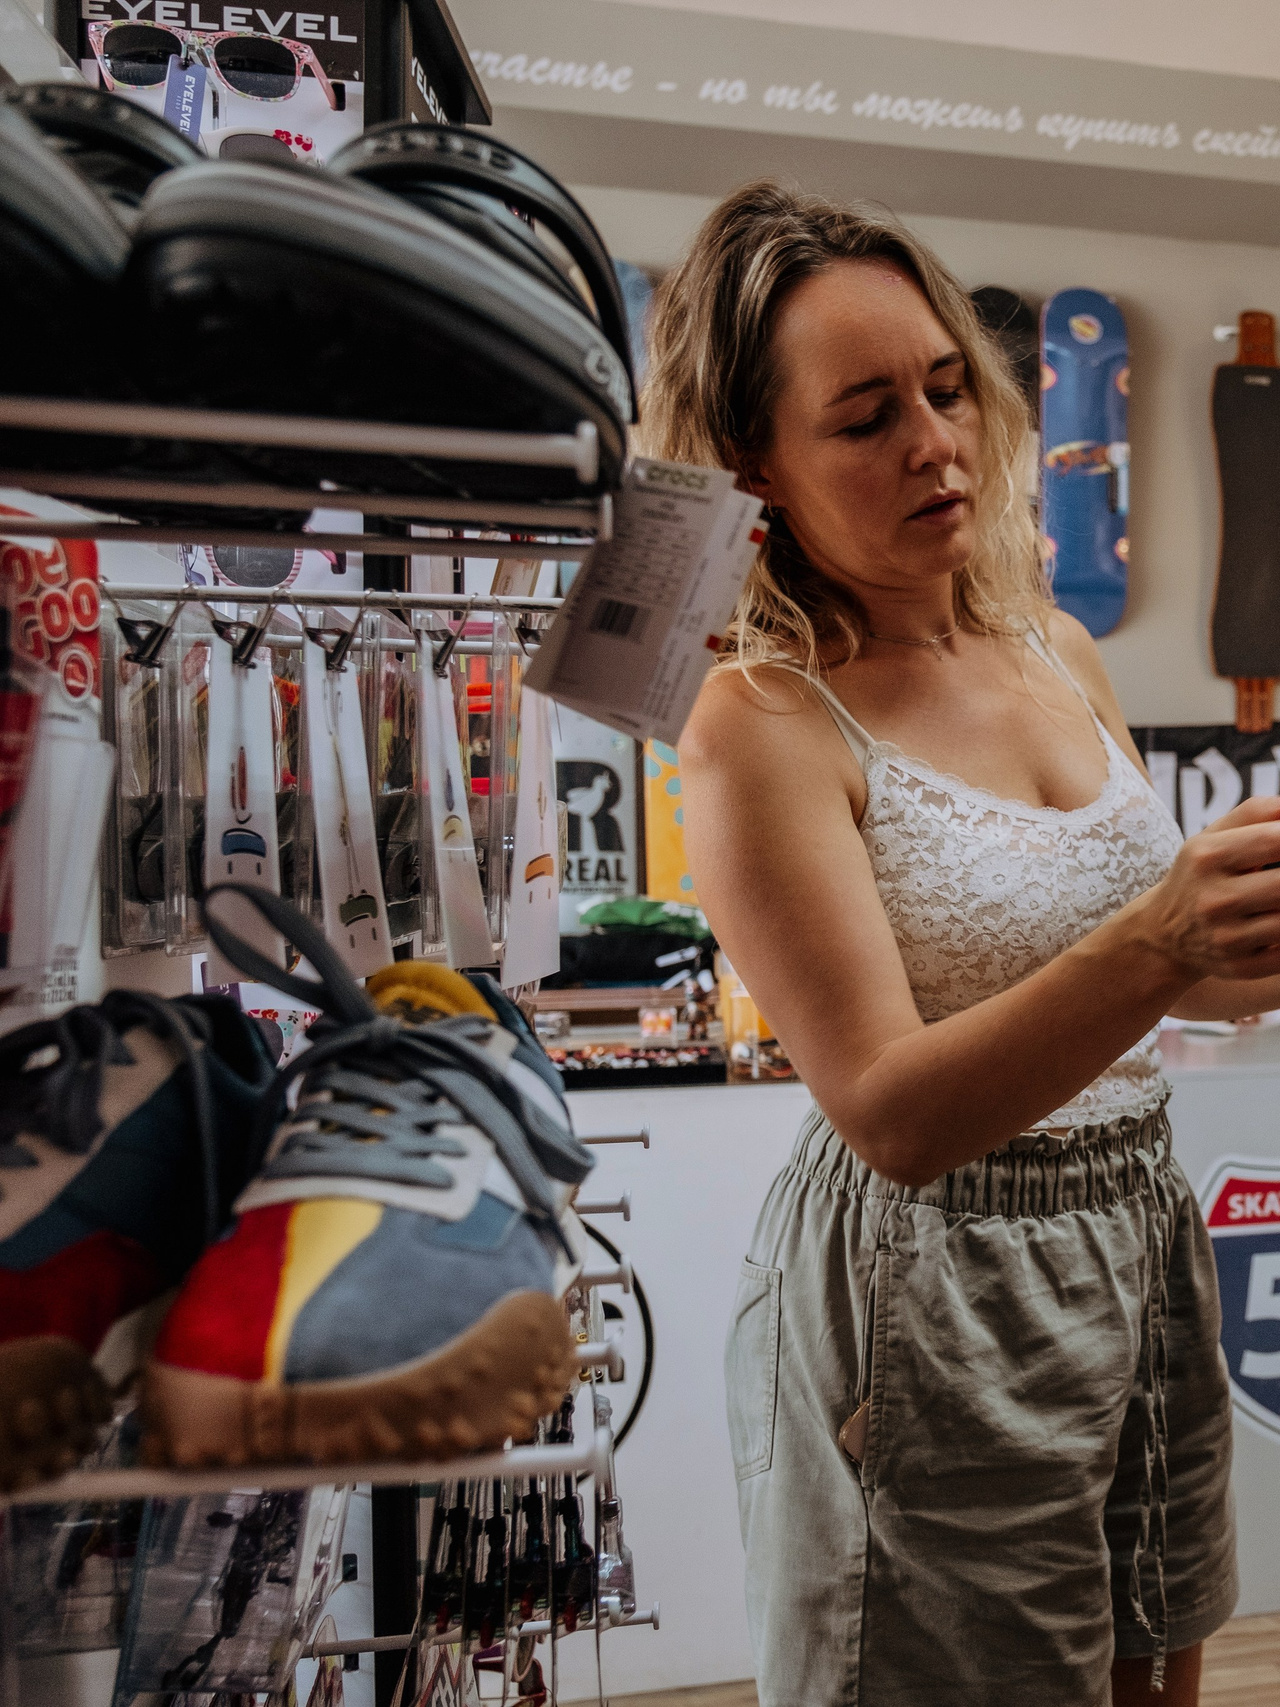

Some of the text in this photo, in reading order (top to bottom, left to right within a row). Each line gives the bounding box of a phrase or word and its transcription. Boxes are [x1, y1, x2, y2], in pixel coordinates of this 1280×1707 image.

[81, 0, 357, 43] EYELEVEL
[179, 75, 196, 133] EYELEVEL
[699, 79, 748, 103] но
[763, 81, 840, 114] ты
[852, 93, 1024, 132] можешь
[1036, 113, 1180, 150] купить
[565, 858, 627, 882] REAL
